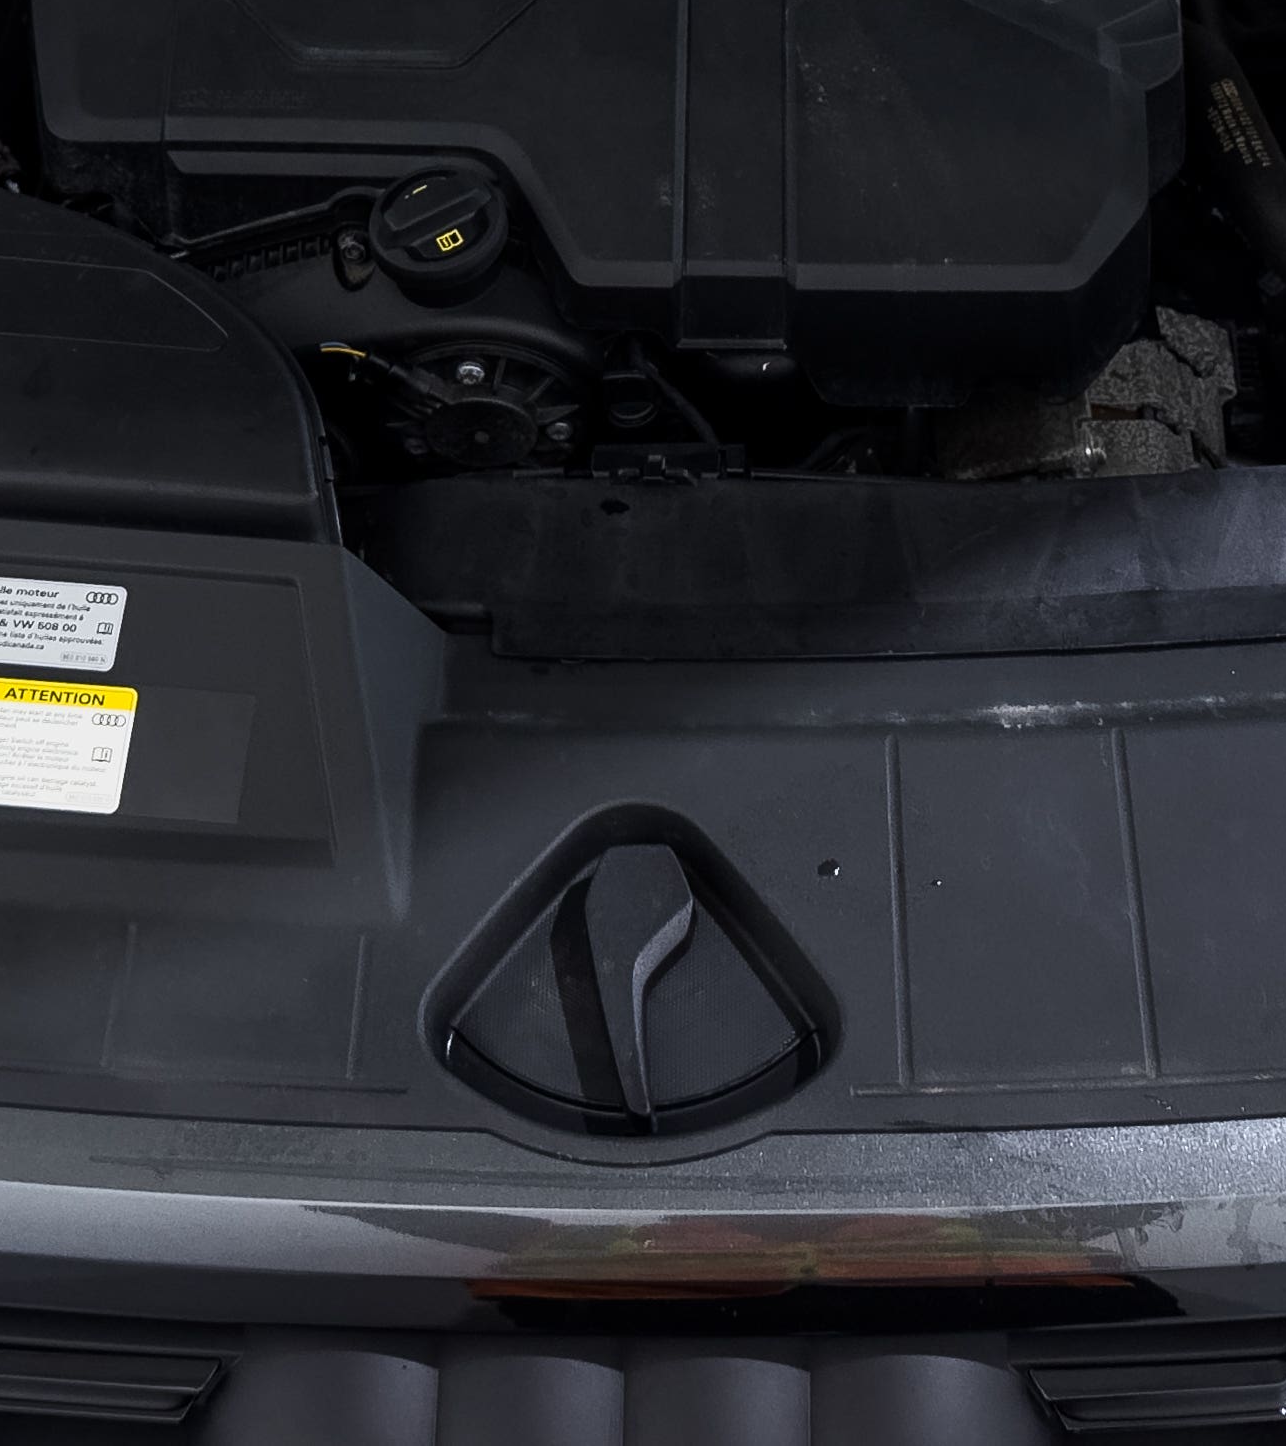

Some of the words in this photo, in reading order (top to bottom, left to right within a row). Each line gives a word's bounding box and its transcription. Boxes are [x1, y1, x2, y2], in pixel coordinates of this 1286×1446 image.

[16, 588, 59, 598] moteur
[13, 619, 35, 630] VW
[37, 621, 59, 631] 508
[62, 623, 77, 633] 00
[4, 687, 106, 706] ATTENTION
